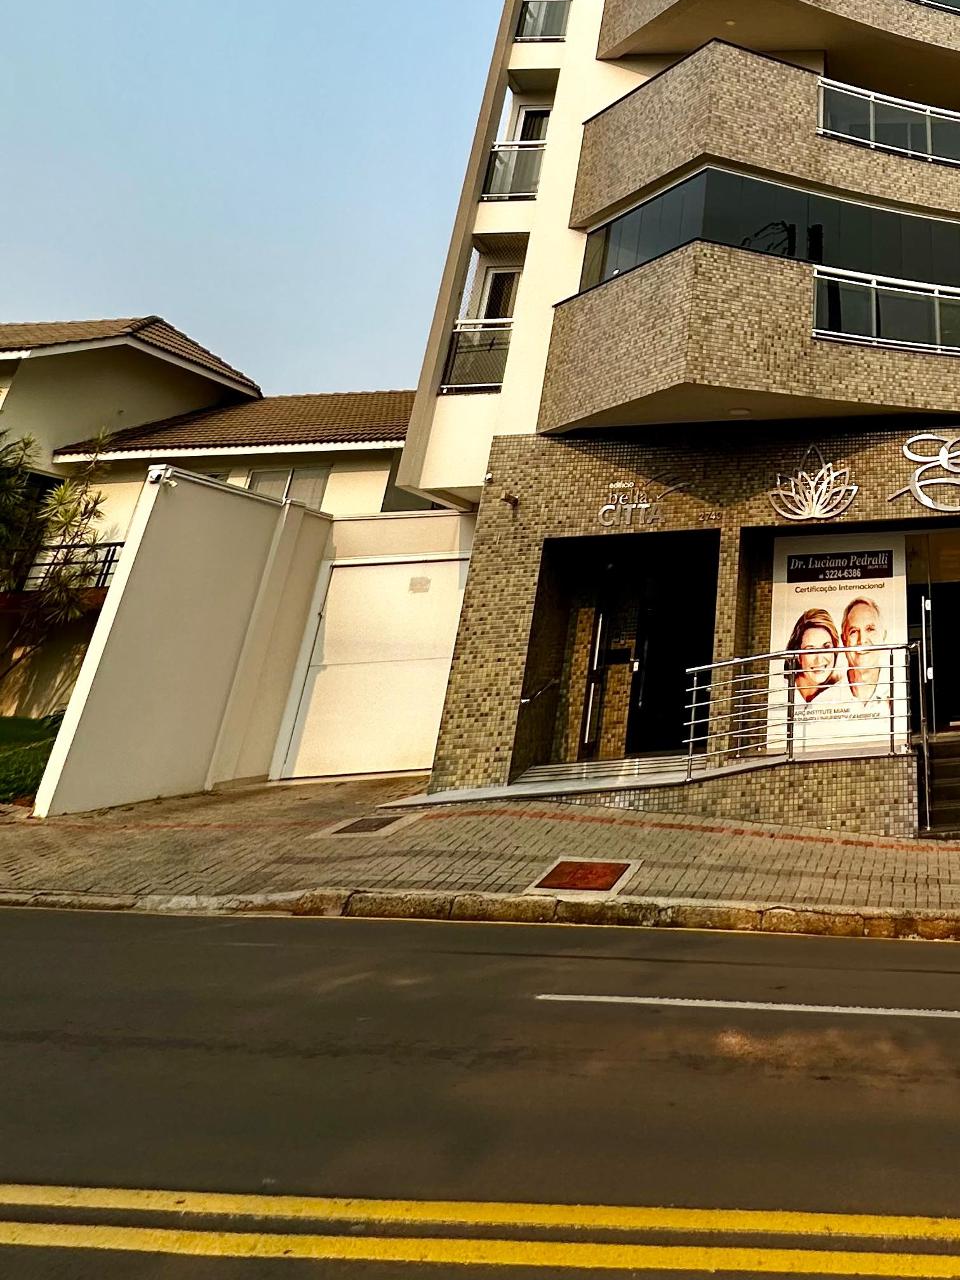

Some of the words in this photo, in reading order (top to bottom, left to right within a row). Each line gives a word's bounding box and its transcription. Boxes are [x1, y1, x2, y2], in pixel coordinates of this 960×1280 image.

[609, 488, 648, 505] bella
[790, 558, 806, 569] Dr.
[808, 556, 848, 569] Luciano
[850, 553, 889, 566] Pedralli
[825, 568, 861, 579] 3224-6386
[795, 584, 837, 593] Certificação
[839, 582, 885, 591] Internacional
